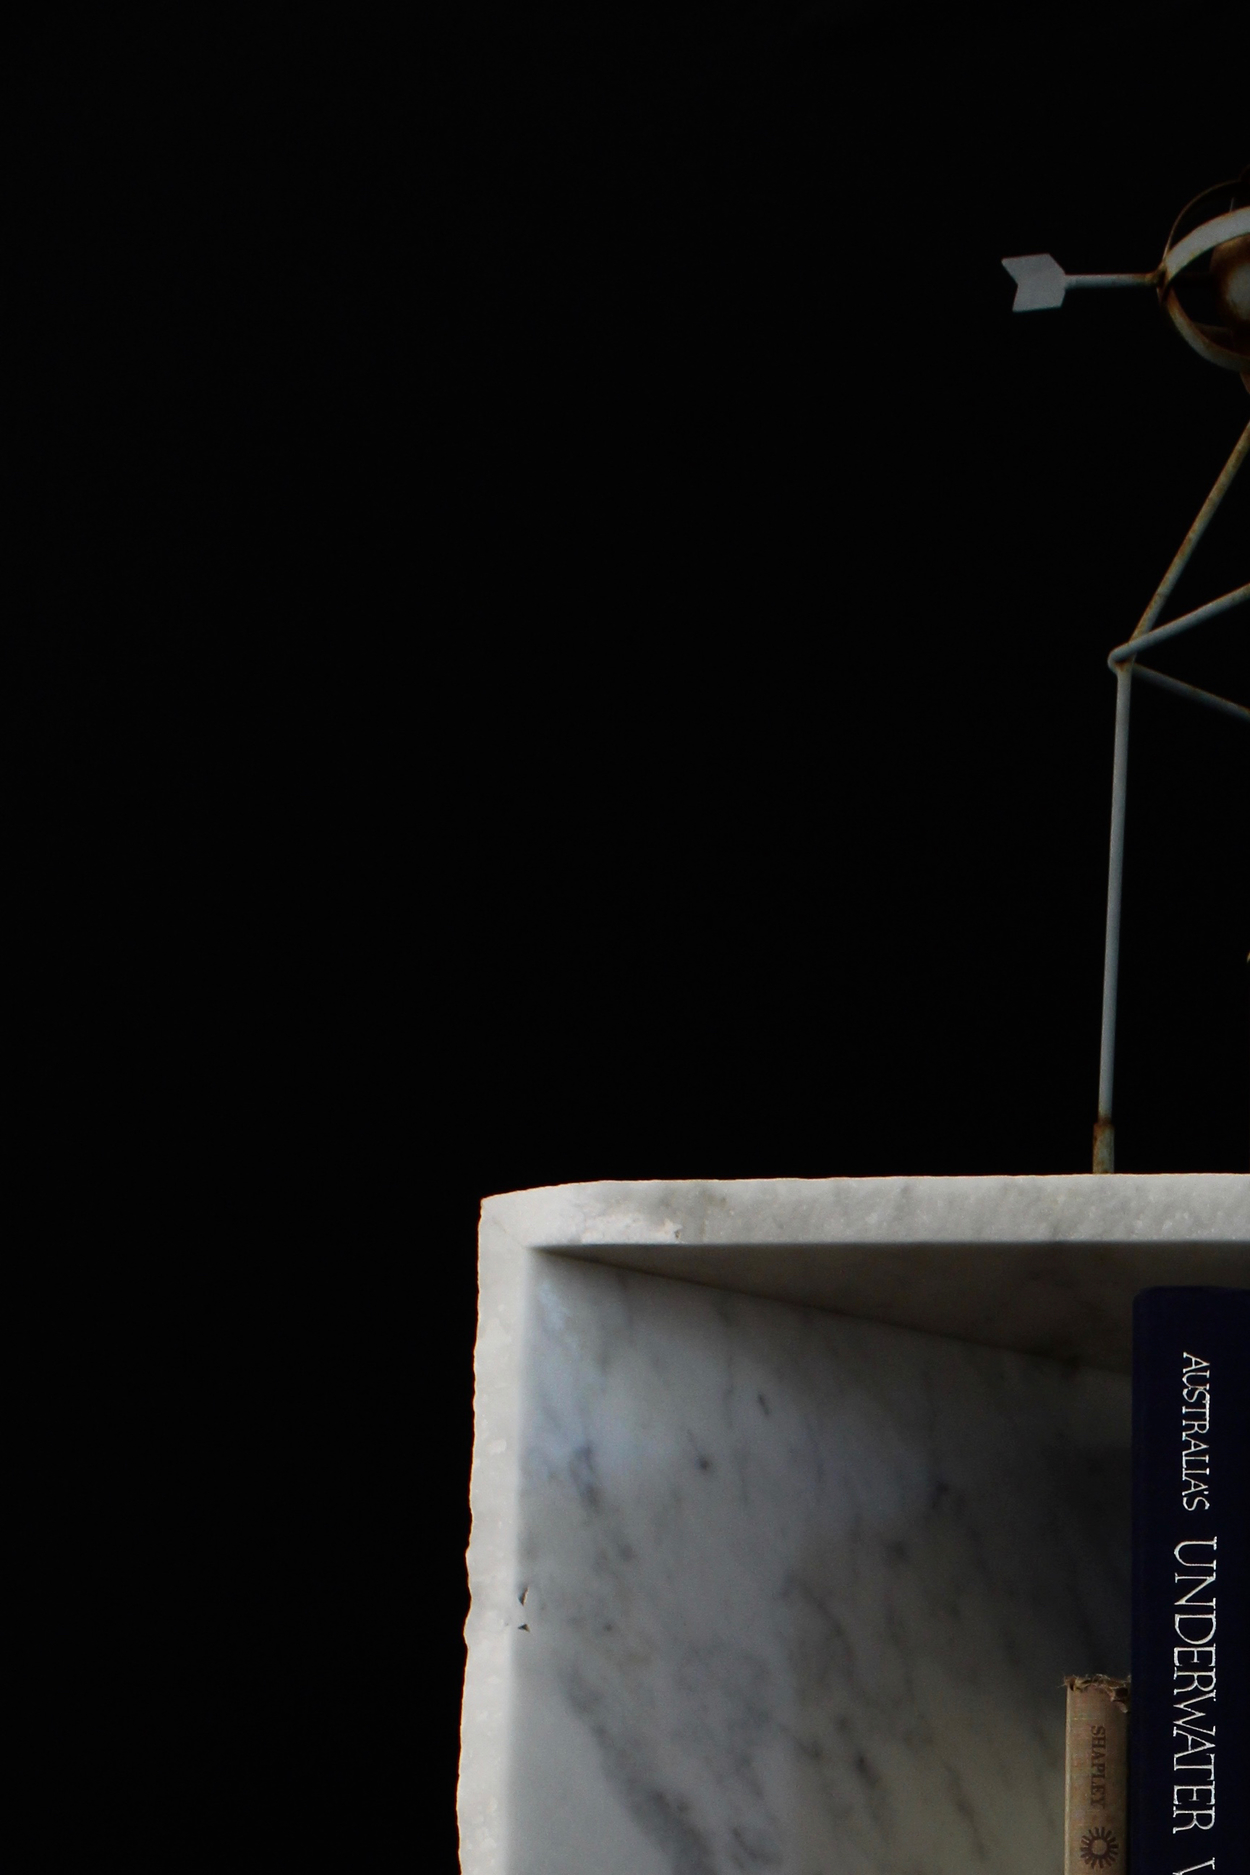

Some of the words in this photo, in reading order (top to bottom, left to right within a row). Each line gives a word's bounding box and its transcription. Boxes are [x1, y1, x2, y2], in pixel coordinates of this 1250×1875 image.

[1182, 1351, 1210, 1511] AUSTRALIA'S
[1172, 1536, 1217, 1834] UNDERWATER
[1089, 1725, 1107, 1808] SHAPLEY
